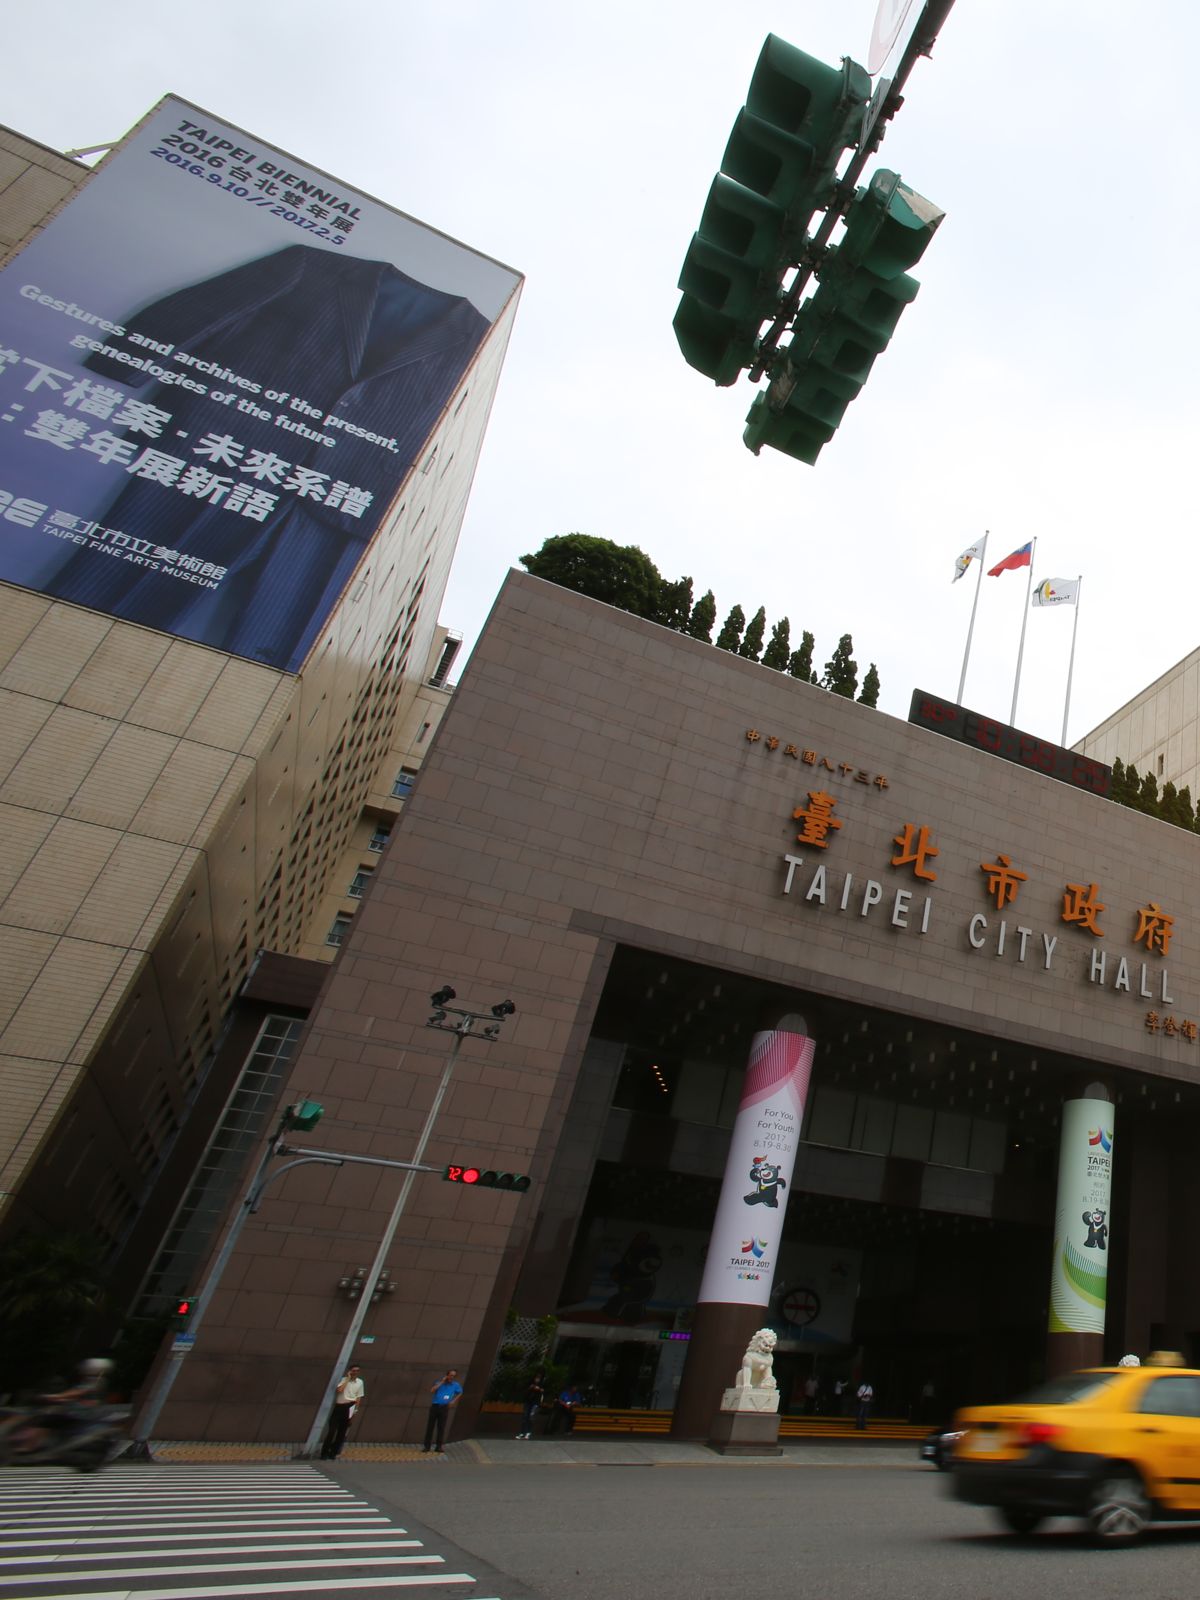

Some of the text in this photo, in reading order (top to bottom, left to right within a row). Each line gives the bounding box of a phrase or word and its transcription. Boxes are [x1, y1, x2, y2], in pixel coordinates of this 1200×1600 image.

[161, 133, 355, 235] 2016 台北雙年展
[176, 119, 362, 222] TAIPEI BIENNIAL
[20, 284, 400, 454] Gestures and archives of the present,
[69, 334, 337, 448] genealogies of the future
[42, 523, 220, 591] TAIPEI FINE ARTS MUSEUM
[792, 788, 1175, 957] 臺北市政府
[783, 853, 1174, 1005] TAIPEI CITY HALL
[757, 1120, 795, 1134] For Youth
[764, 1108, 794, 1121] For You
[1087, 1156, 1111, 1168] TAIPEI
[730, 1258, 771, 1269] TAIPEI 2017
